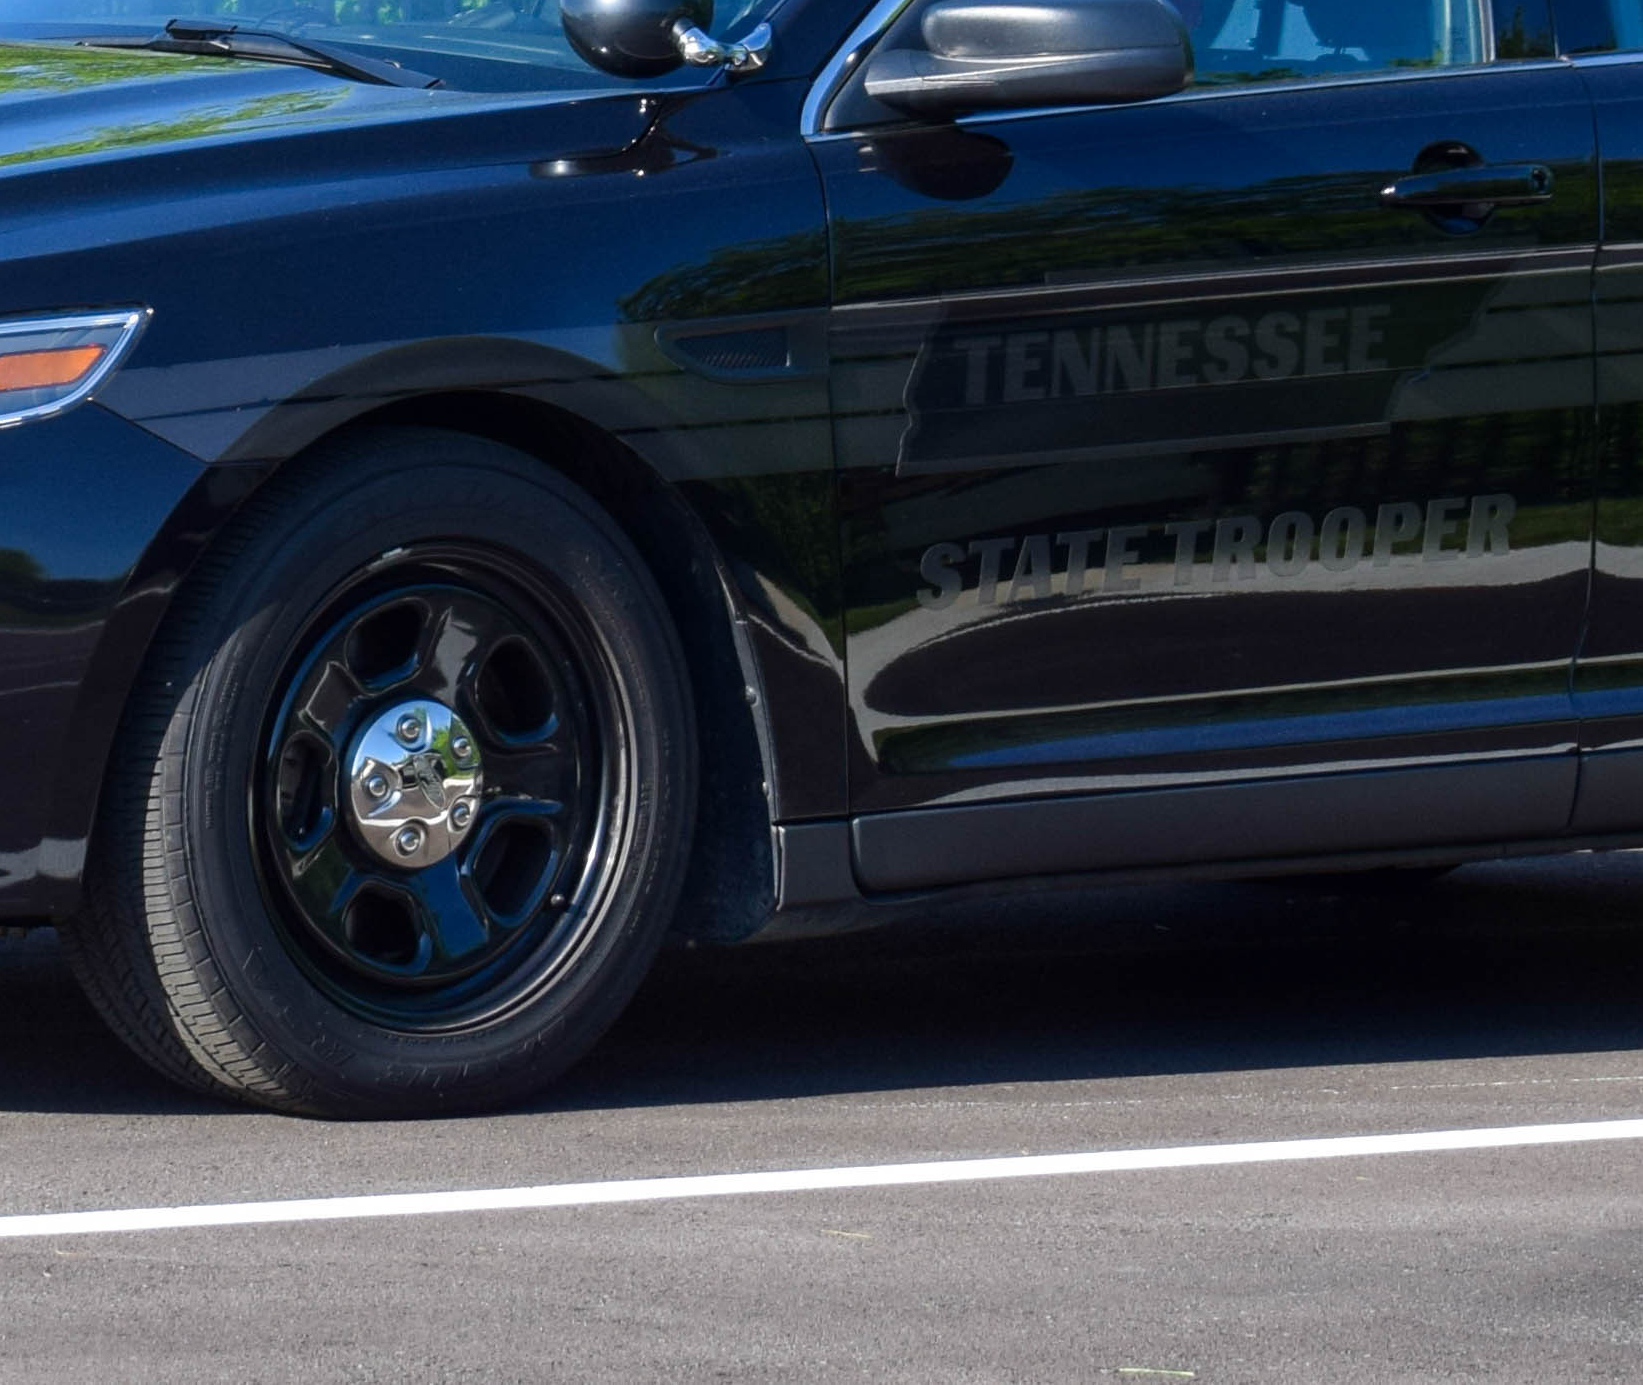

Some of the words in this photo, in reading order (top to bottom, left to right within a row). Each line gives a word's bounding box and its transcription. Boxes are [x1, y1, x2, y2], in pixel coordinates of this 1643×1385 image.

[954, 304, 1392, 406] TENNESSEE
[917, 526, 1147, 611] STATE
[1165, 493, 1517, 588] TROOPER
